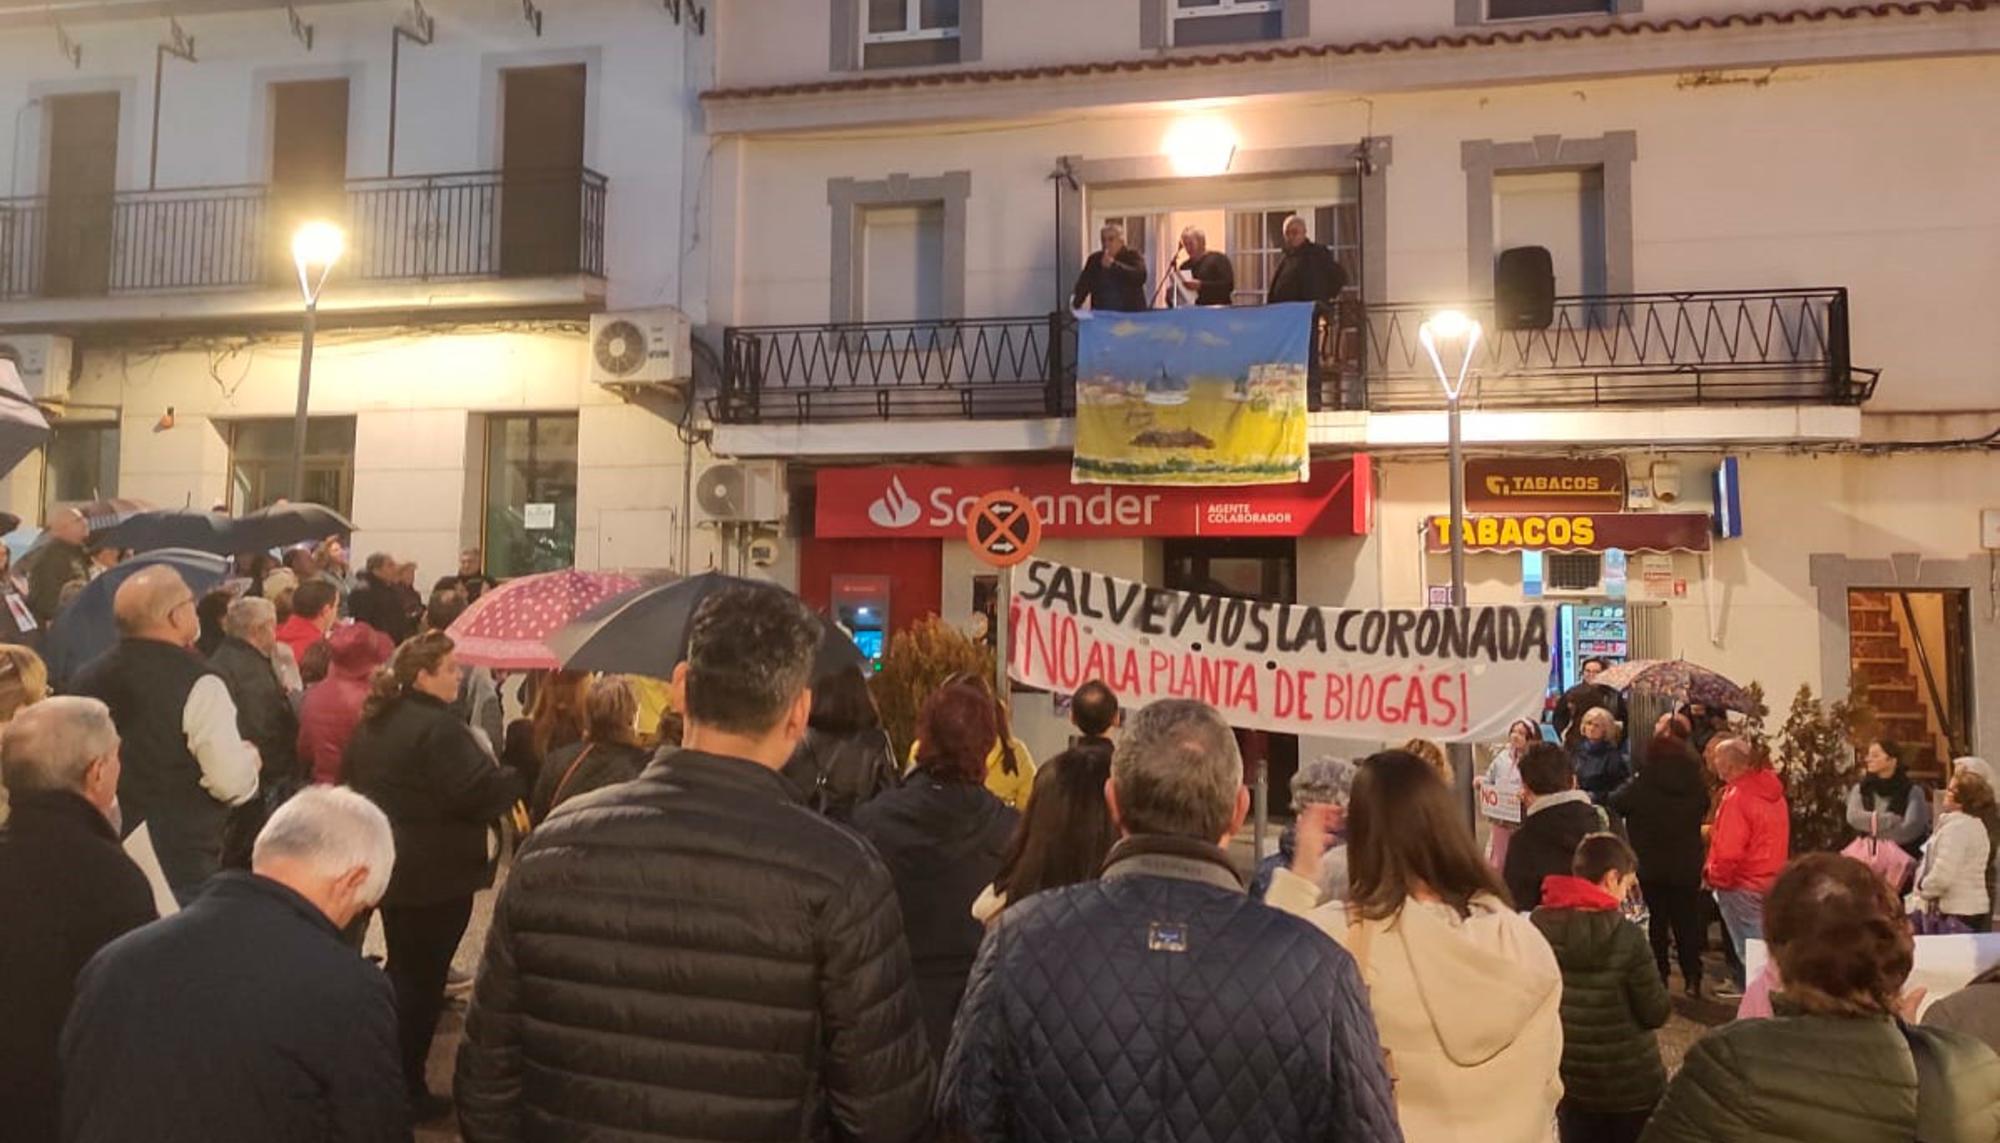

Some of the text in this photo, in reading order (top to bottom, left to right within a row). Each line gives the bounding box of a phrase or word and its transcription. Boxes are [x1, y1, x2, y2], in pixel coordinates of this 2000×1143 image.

[1512, 476, 1599, 490] TABACOS
[929, 486, 1161, 527] Saander
[1207, 503, 1250, 513] AGENTE
[1207, 513, 1292, 524] COLABORADOR
[1019, 560, 1269, 653] SALVEMOS
[1335, 605, 1549, 662] CORONADA
[1150, 650, 1258, 713] PLANTA
[1274, 668, 1317, 720] DE
[1481, 788, 1498, 806] NO
